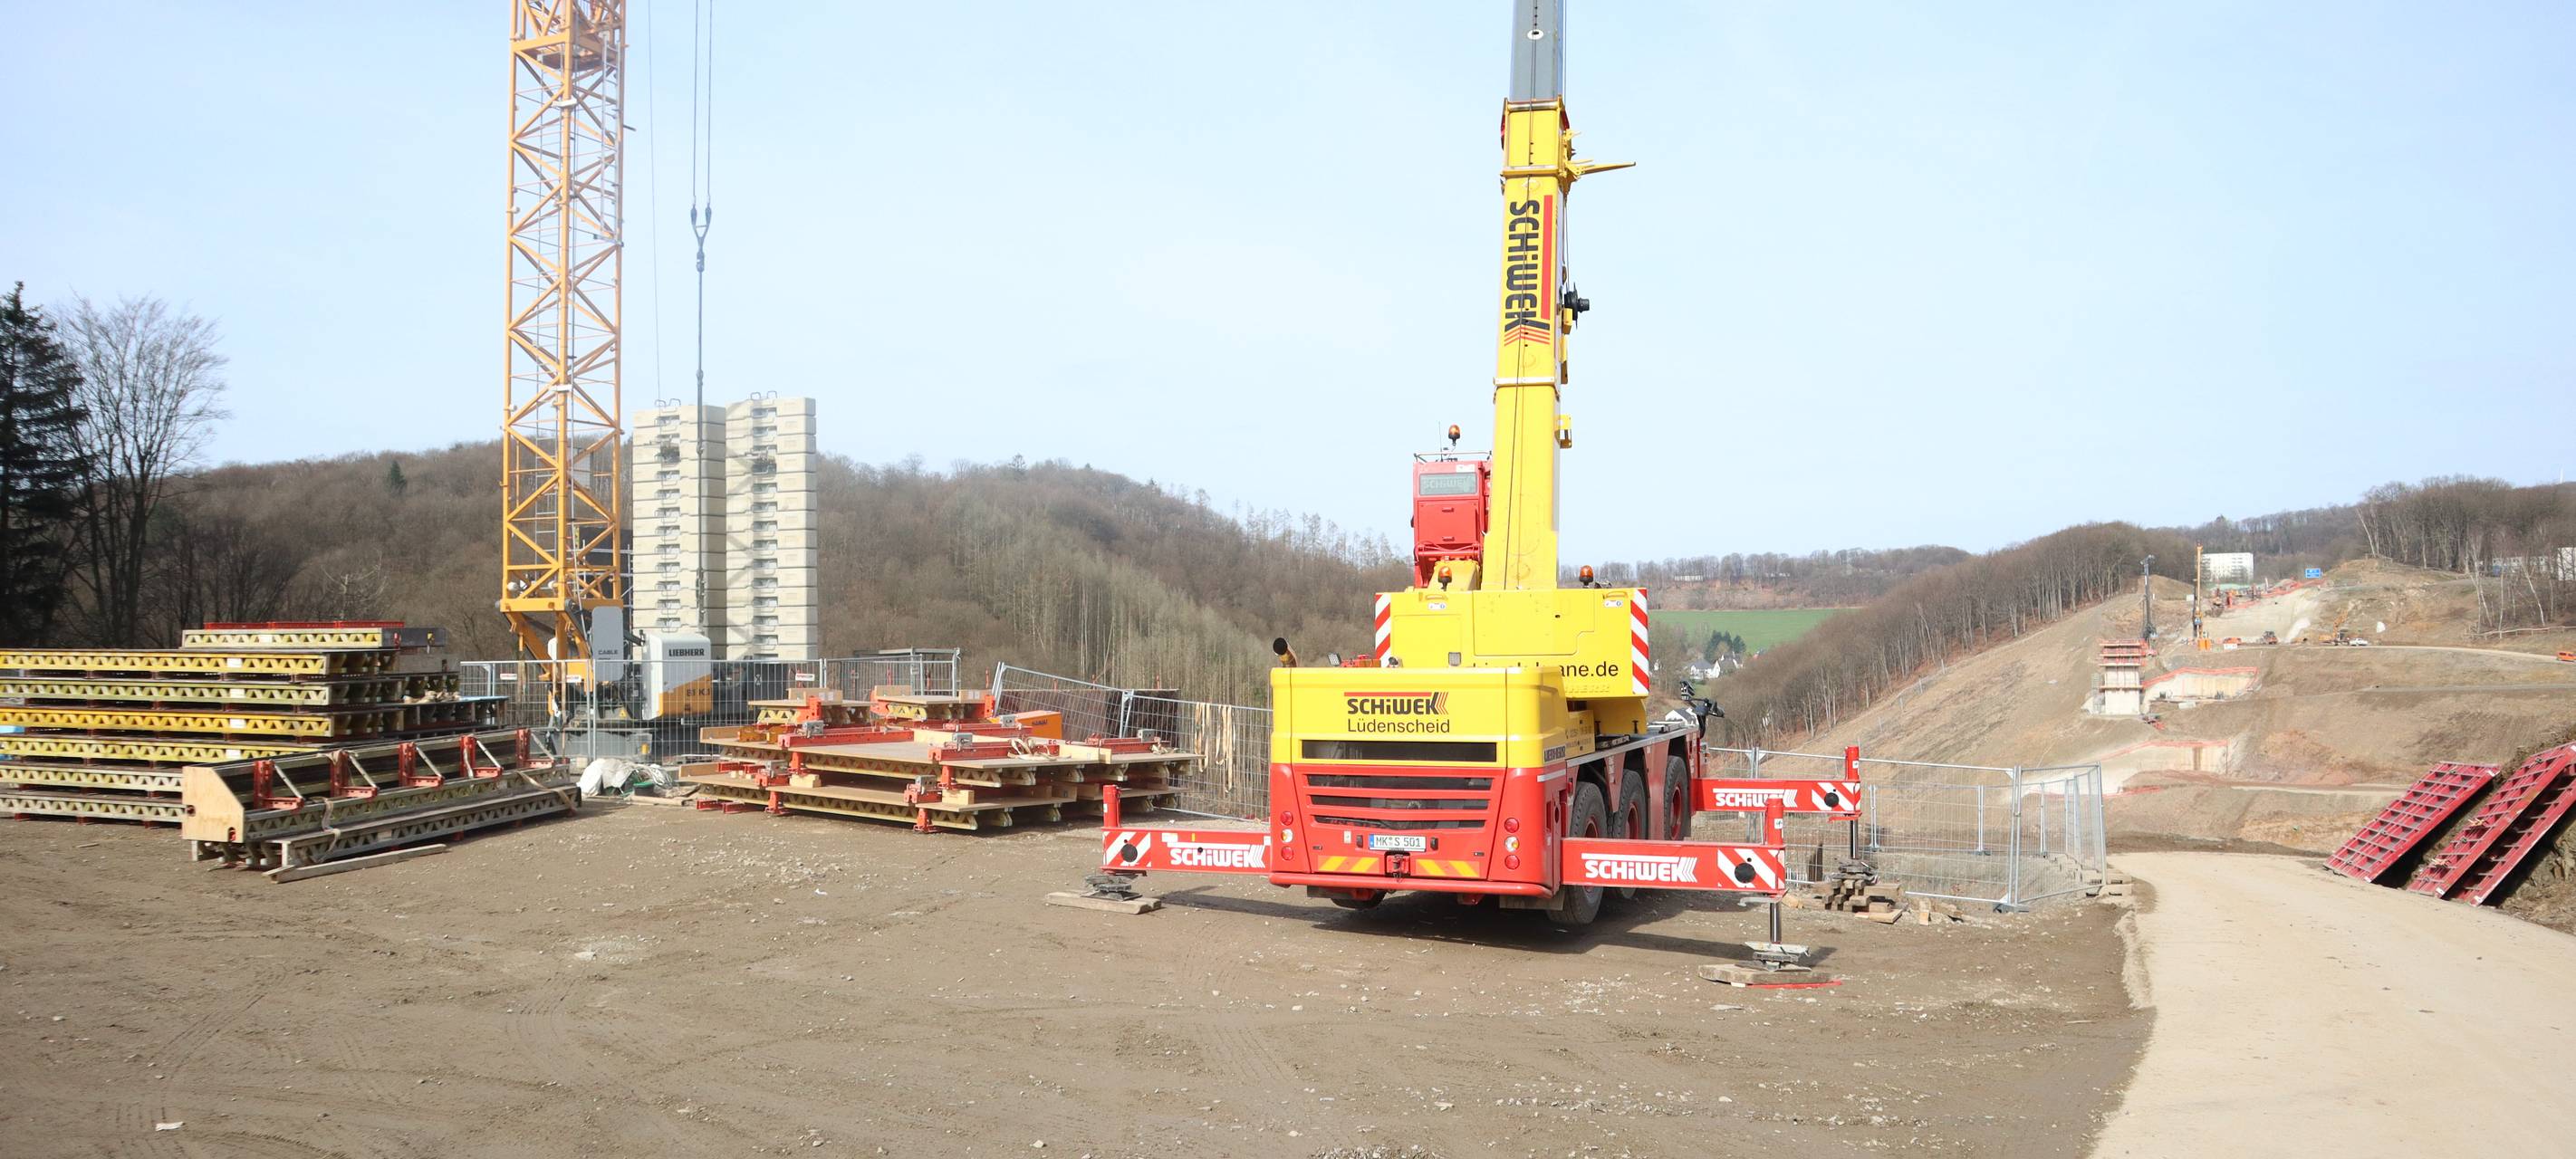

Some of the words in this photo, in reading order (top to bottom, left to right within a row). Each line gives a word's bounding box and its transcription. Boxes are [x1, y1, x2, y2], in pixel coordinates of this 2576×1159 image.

[668, 648, 705, 657] LIEBHERR
[1559, 661, 1619, 677] ane.de
[1348, 718, 1450, 733] Lüdenscheid
[1375, 836, 1389, 847] MK
[1394, 837, 1400, 847] S
[1403, 838, 1421, 848] 501
